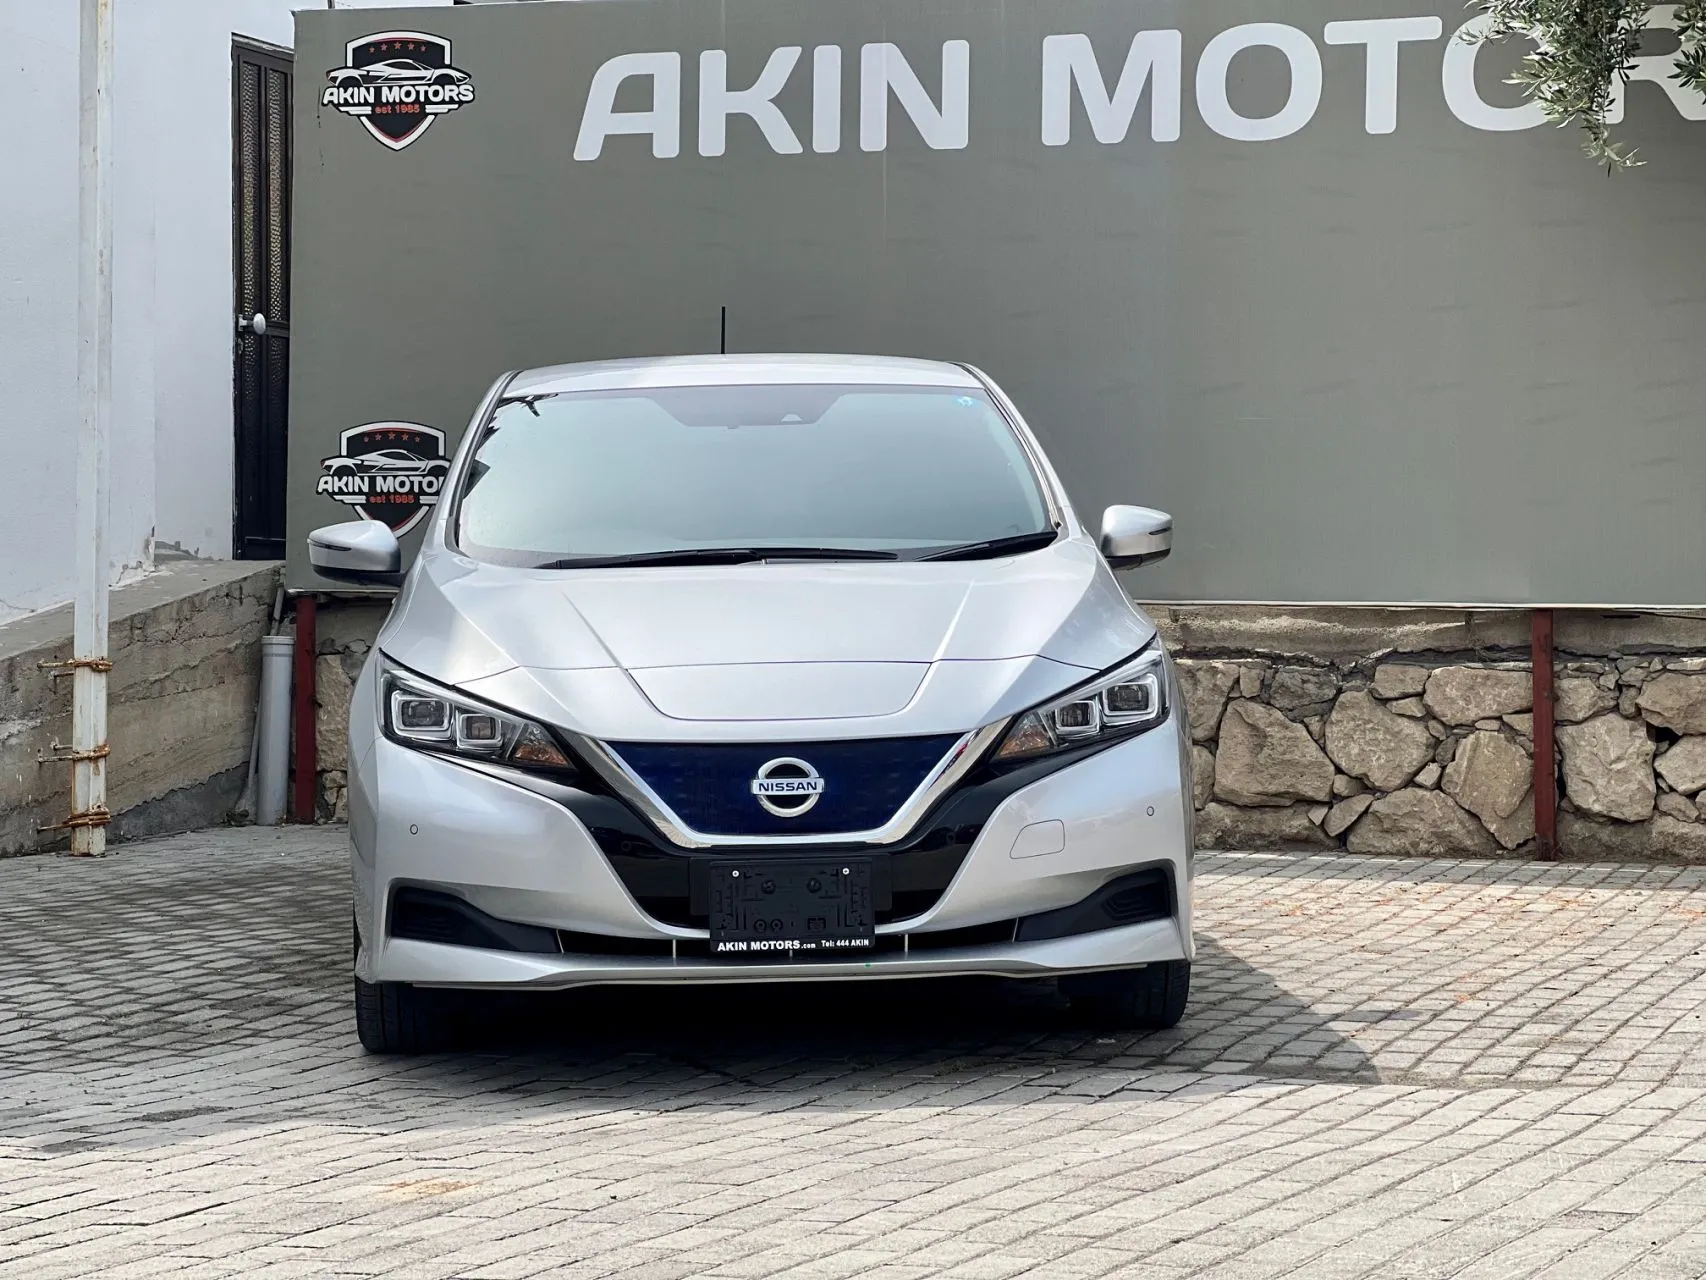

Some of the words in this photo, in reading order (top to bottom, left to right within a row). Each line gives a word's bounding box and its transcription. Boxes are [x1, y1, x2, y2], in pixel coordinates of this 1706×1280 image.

[323, 86, 375, 105] AKIN
[381, 84, 474, 104] MOTORS
[573, 39, 970, 161] AKIN
[375, 104, 392, 114] est
[395, 103, 420, 114] 1985
[317, 475, 369, 493] AKIN
[375, 475, 443, 493] MOTO
[369, 495, 386, 504] est
[758, 781, 817, 792] NISSAN
[717, 941, 747, 951] AKIN
[821, 939, 834, 948] Tel:
[836, 939, 849, 948] 444
[851, 938, 869, 947] AKIN
